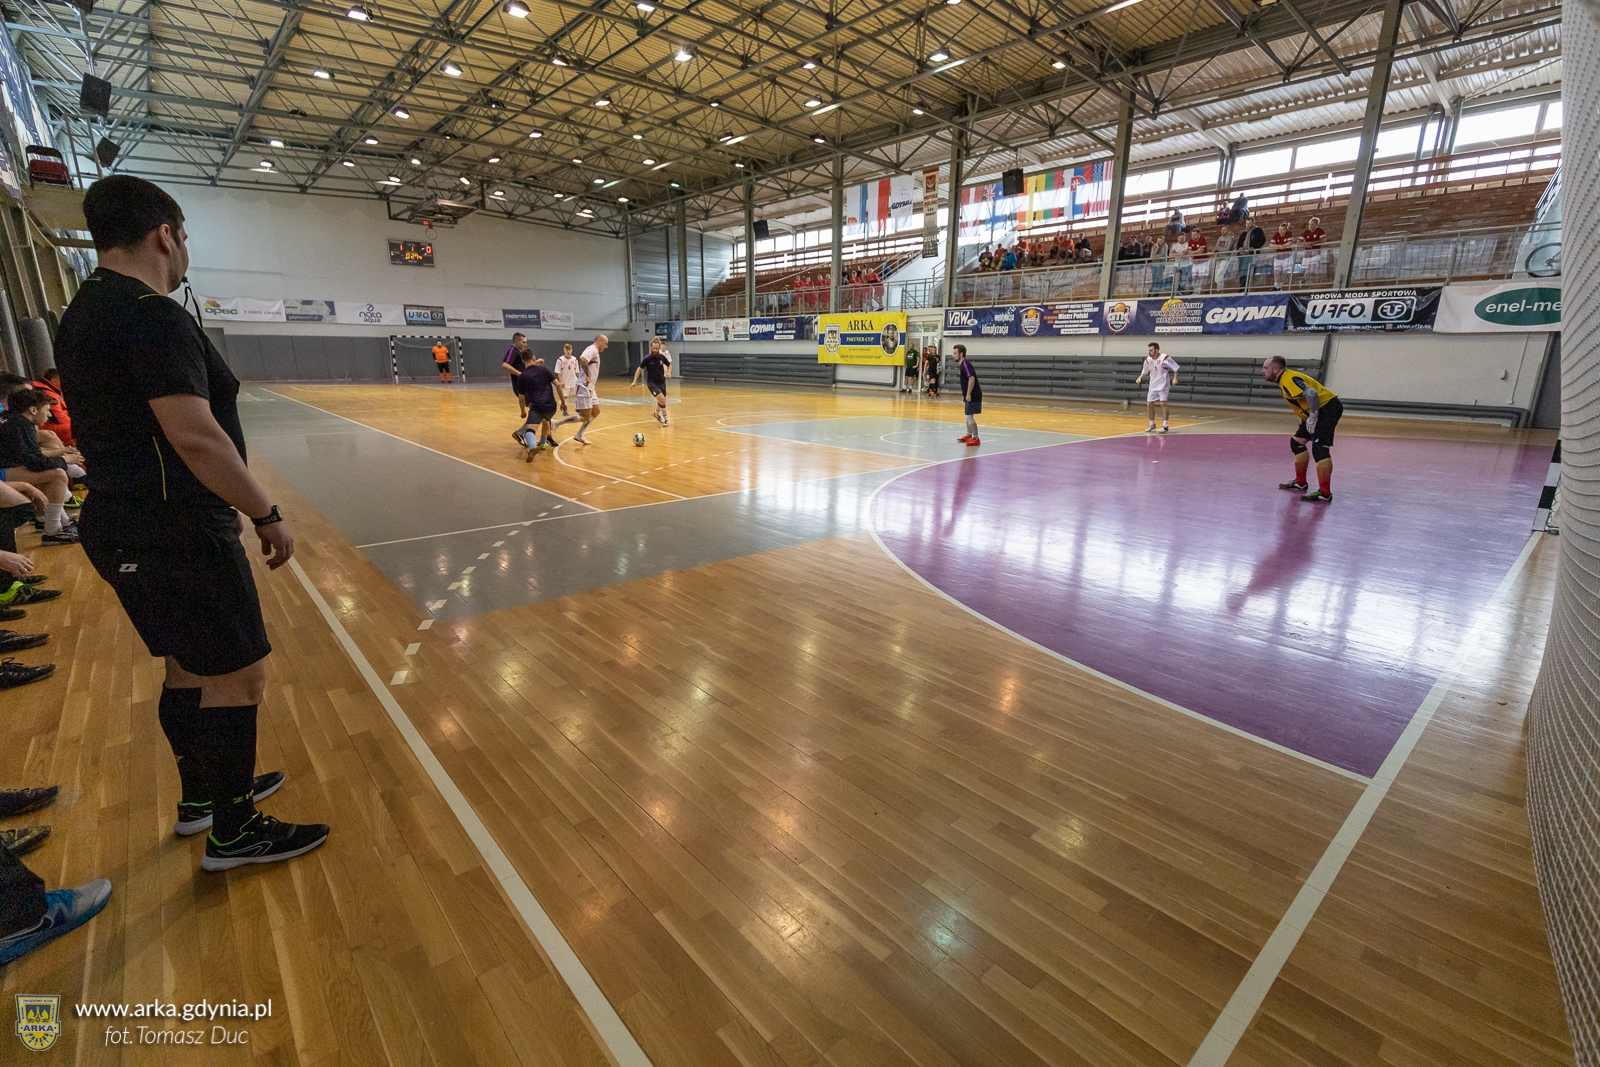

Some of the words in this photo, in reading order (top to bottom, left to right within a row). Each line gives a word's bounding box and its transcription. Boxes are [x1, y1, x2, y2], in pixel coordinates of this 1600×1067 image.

[1371, 290, 1417, 298] SPORTOWA
[204, 307, 239, 316] opec
[1205, 305, 1287, 325] GDYNIA
[949, 311, 971, 326] VBW
[750, 323, 775, 334] GDYNIA
[847, 320, 874, 331] ARKA
